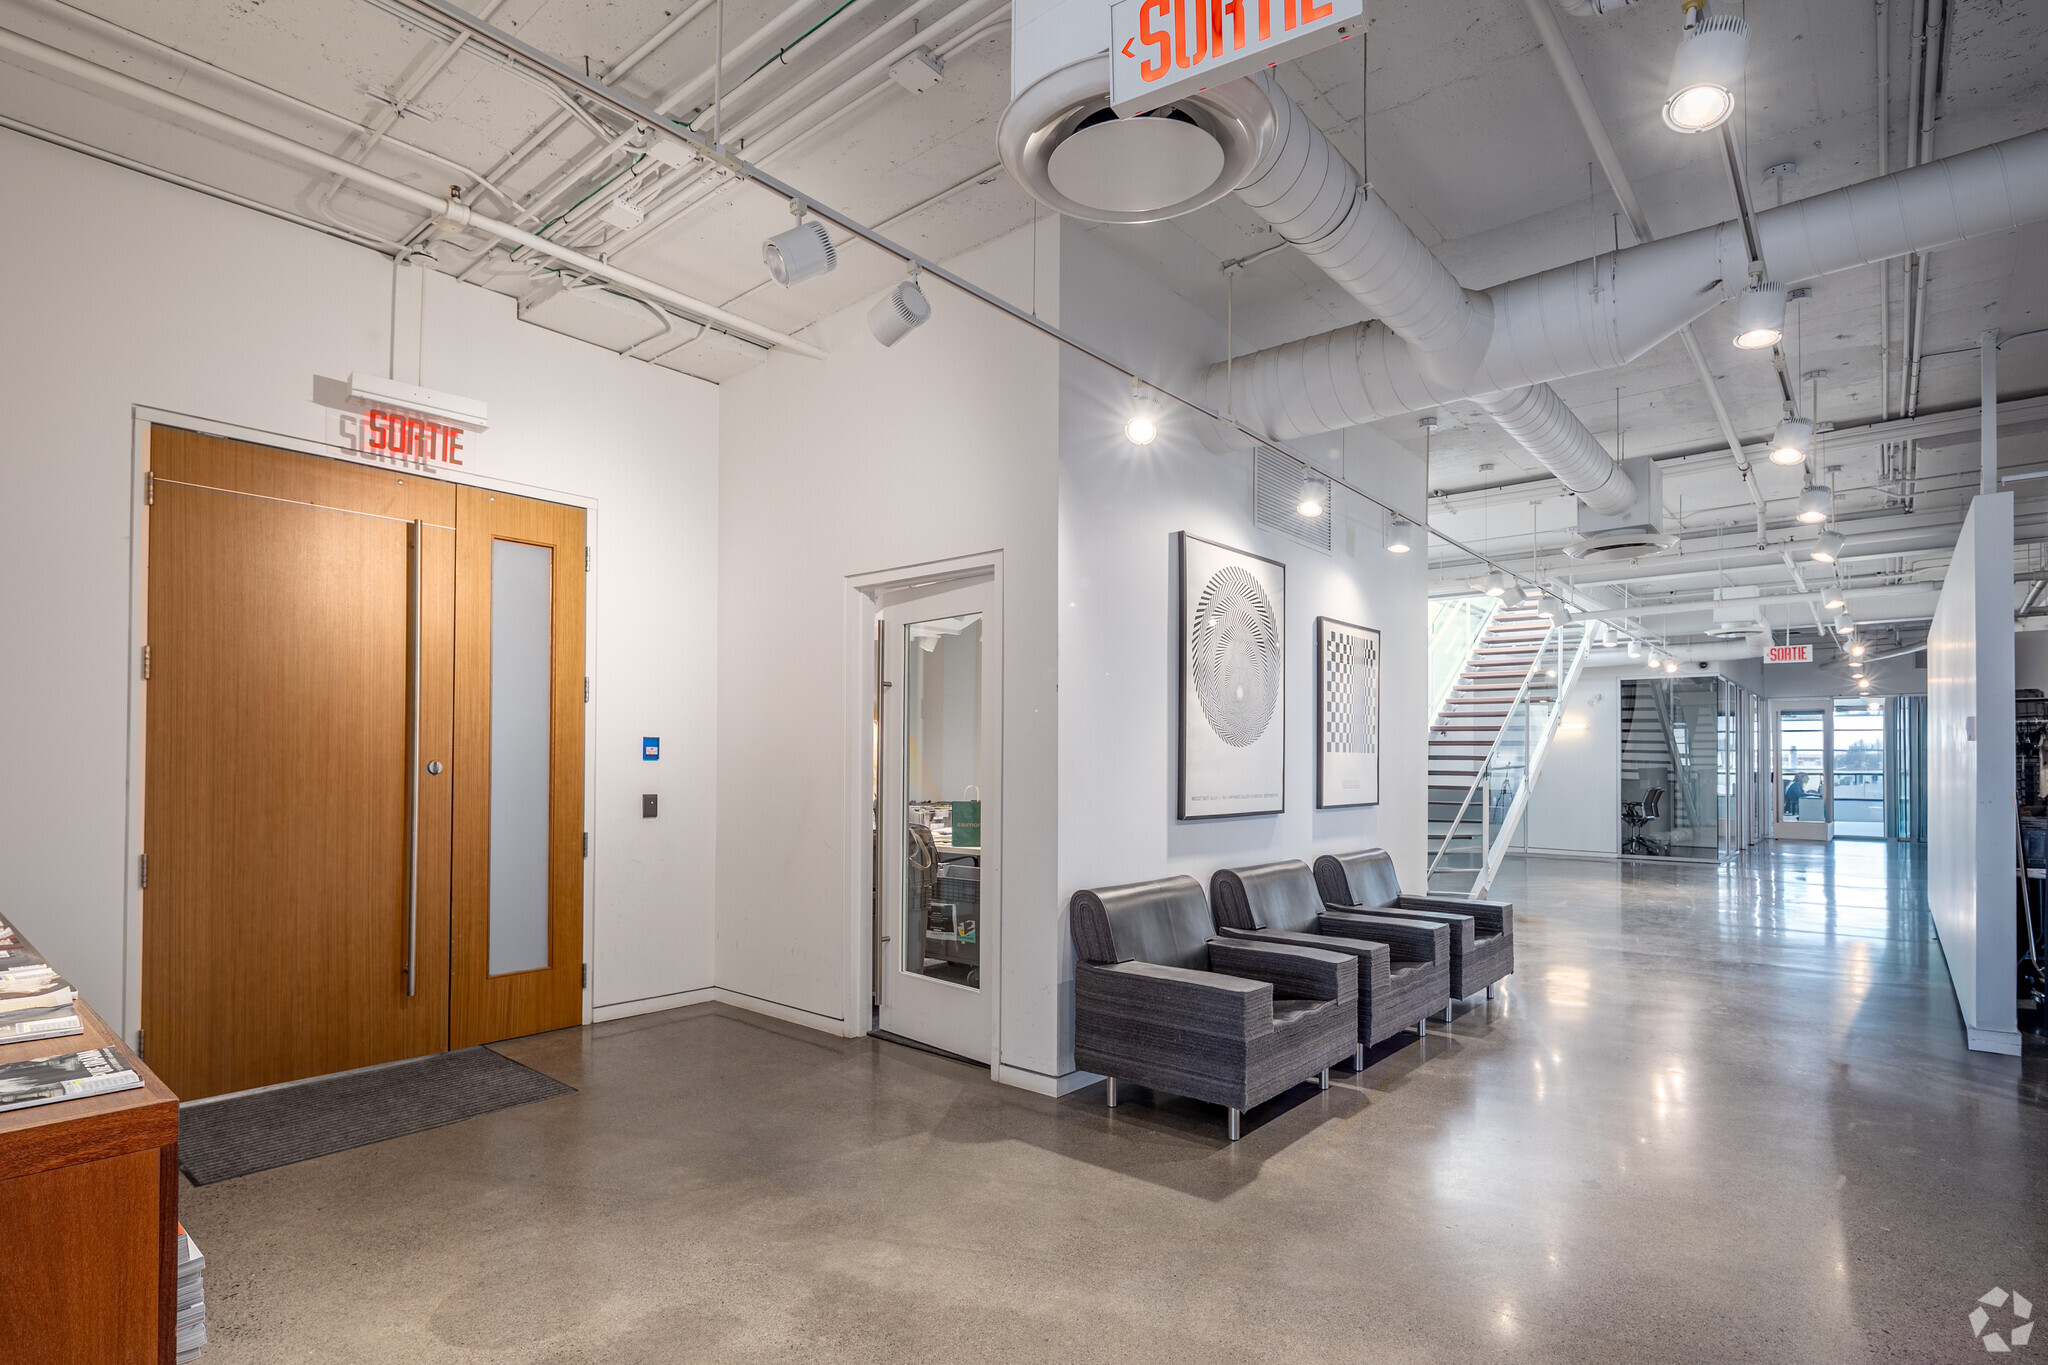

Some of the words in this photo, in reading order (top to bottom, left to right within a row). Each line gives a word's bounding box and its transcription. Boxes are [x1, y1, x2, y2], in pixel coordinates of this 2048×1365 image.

[1139, 0, 1333, 83] SOR
[369, 408, 464, 466] SORTIE
[1770, 646, 1807, 661] SORTIE
